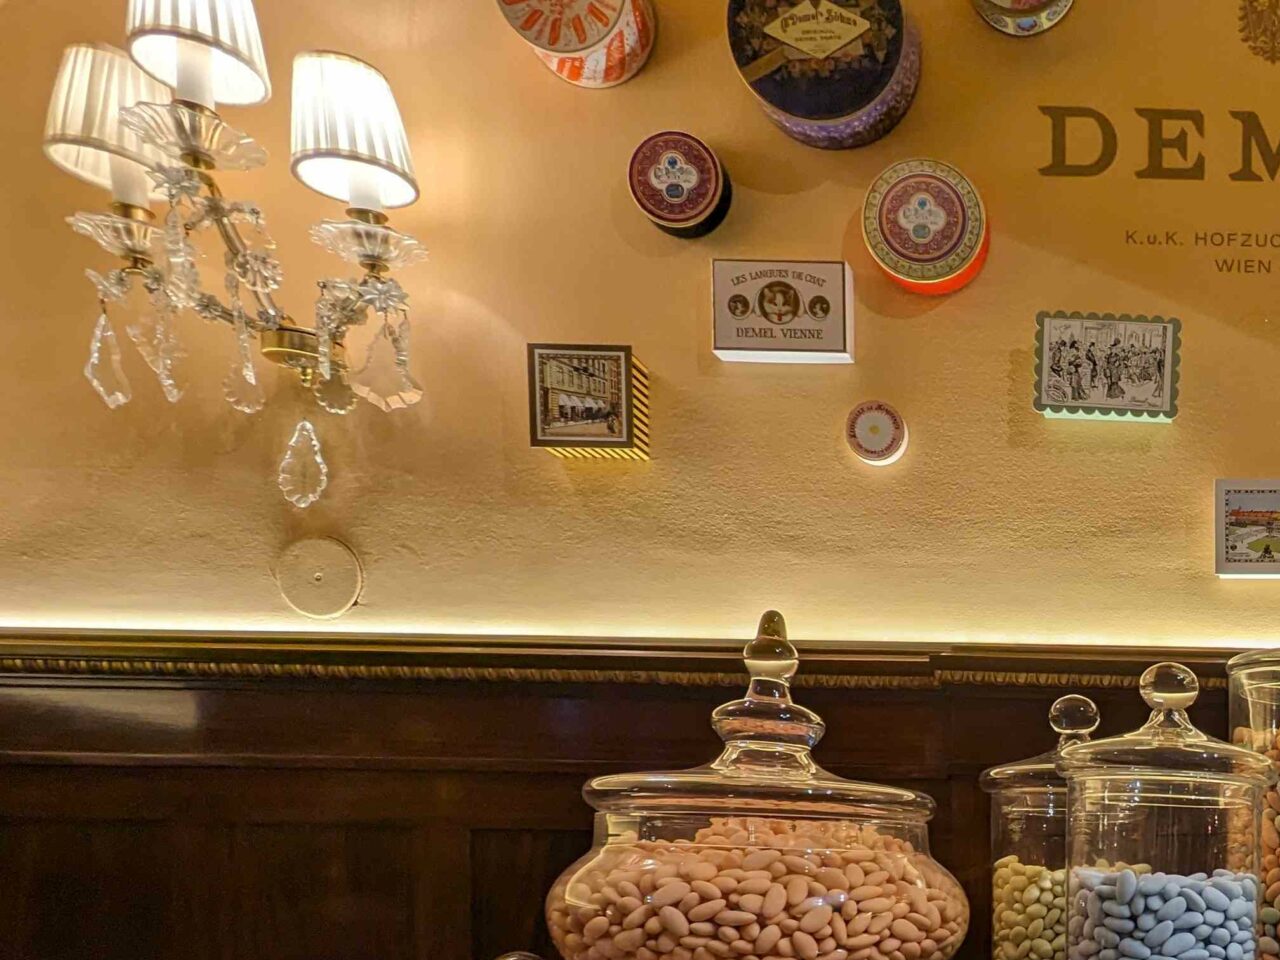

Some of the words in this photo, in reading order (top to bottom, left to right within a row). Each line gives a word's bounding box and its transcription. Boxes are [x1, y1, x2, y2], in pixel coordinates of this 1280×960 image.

[1125, 230, 1184, 247] K.u.K.
[1214, 259, 1272, 274] WIEN
[730, 274, 748, 286] LES
[791, 271, 804, 281] DE
[804, 273, 827, 287] CHAT
[736, 327, 777, 339] DEMEL
[779, 328, 824, 340] VIENNE
